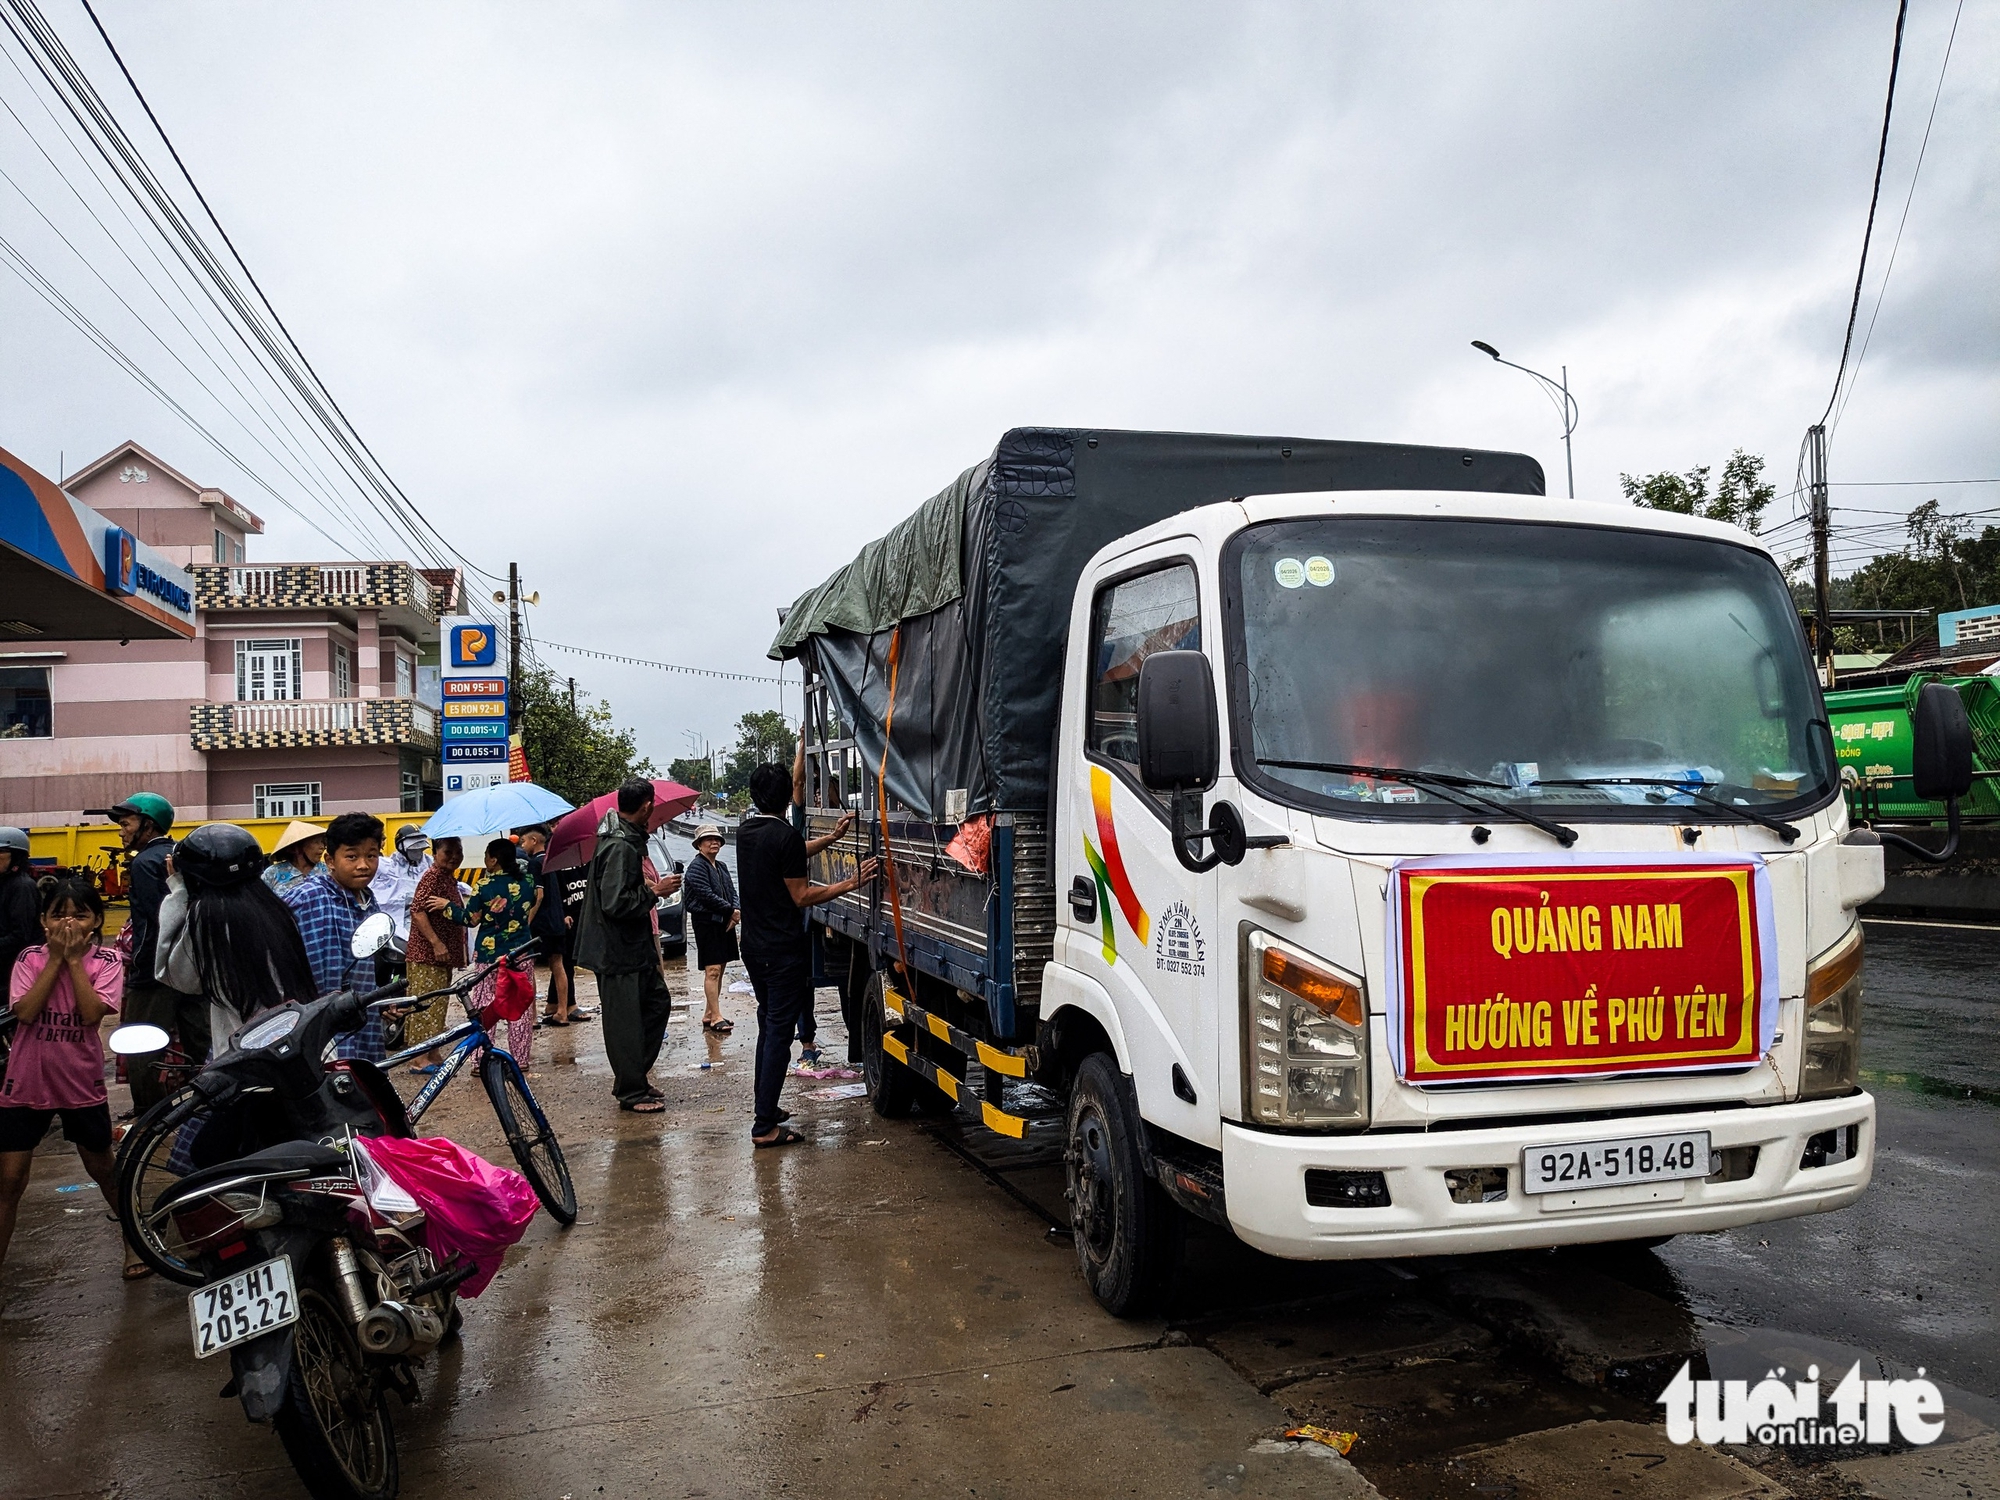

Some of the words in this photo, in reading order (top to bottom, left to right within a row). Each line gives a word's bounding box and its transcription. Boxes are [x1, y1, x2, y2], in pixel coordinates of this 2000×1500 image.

[450, 683, 470, 693] RON
[472, 682, 498, 692] 95-III
[450, 705, 460, 714] E5
[461, 704, 478, 714] RON
[479, 704, 499, 713] 92-II
[451, 726, 462, 734] DO
[452, 748, 463, 757] DO
[1174, 900, 1190, 919] VĂN
[1490, 890, 1601, 959] QUẢNG
[1612, 903, 1683, 950] NAM
[1181, 963, 1192, 975] 552
[1193, 965, 1205, 977] 374
[1445, 992, 1552, 1052] HƯỚNG
[1562, 983, 1600, 1047] VỀ
[1608, 986, 1665, 1044] PHÚ
[1673, 984, 1728, 1038] YÊN
[1540, 1141, 1695, 1183] 92A-518.48
[311, 1182, 357, 1193] BLADE
[204, 1265, 274, 1318] 78-H1
[200, 1290, 292, 1353] 205.22
